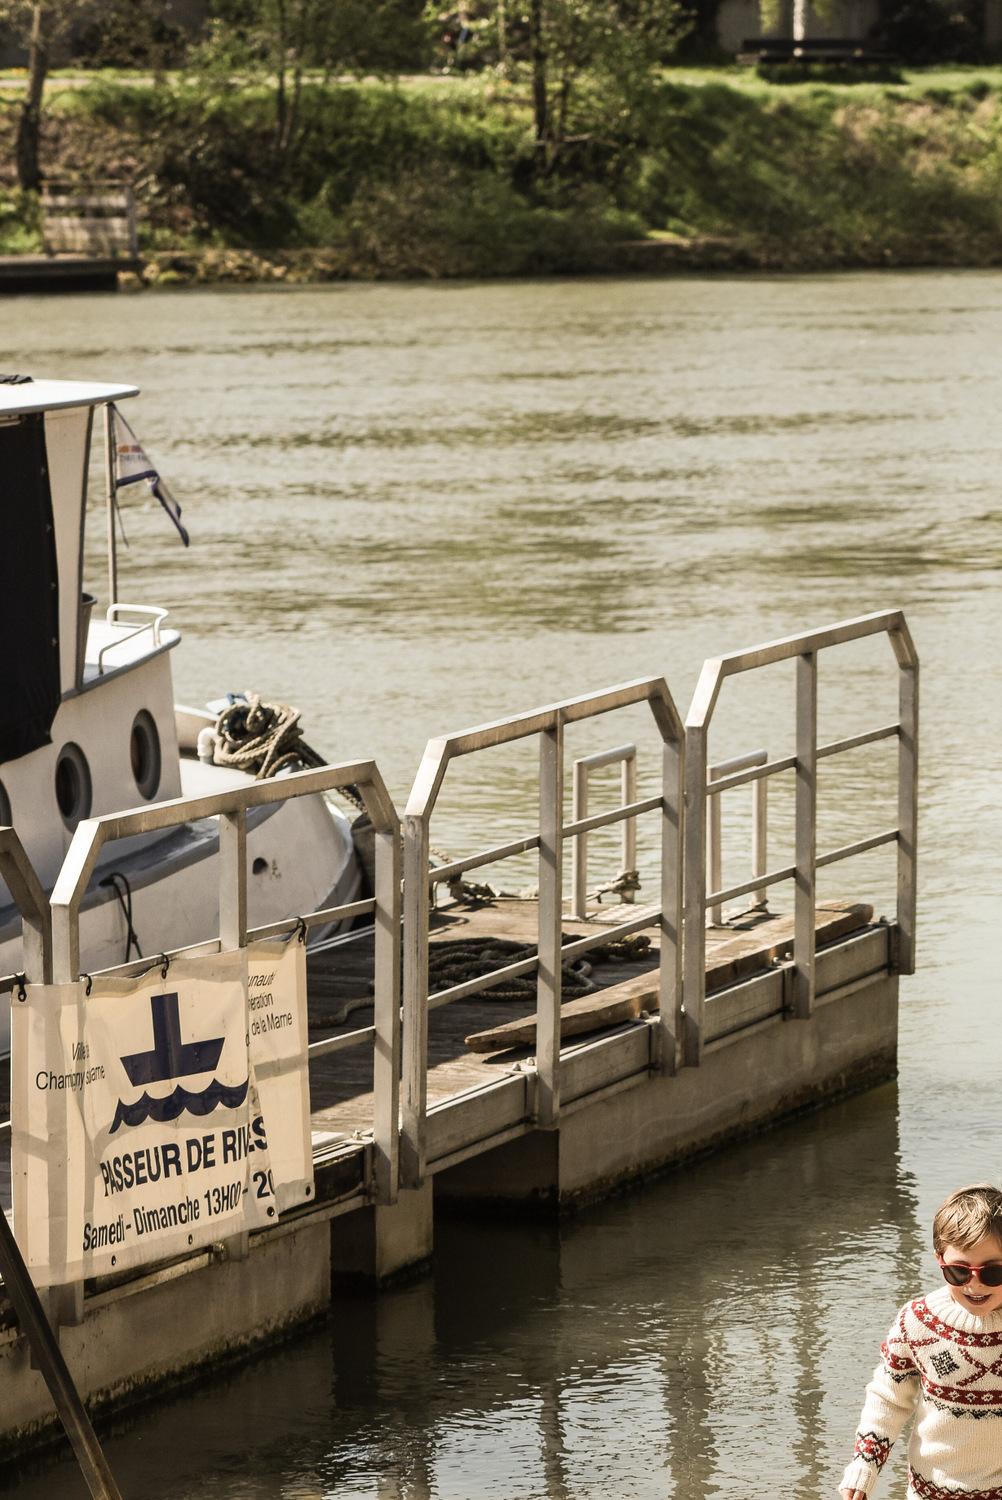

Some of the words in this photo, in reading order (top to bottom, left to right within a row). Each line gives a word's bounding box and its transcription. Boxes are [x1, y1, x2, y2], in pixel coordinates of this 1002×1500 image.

[266, 1012, 293, 1031] Marne
[100, 1143, 182, 1197] PASSEUR
[185, 1134, 216, 1173] DE
[82, 1213, 126, 1251] Samedi
[133, 1196, 200, 1235] Dimanche
[204, 1180, 242, 1216] 13H00
